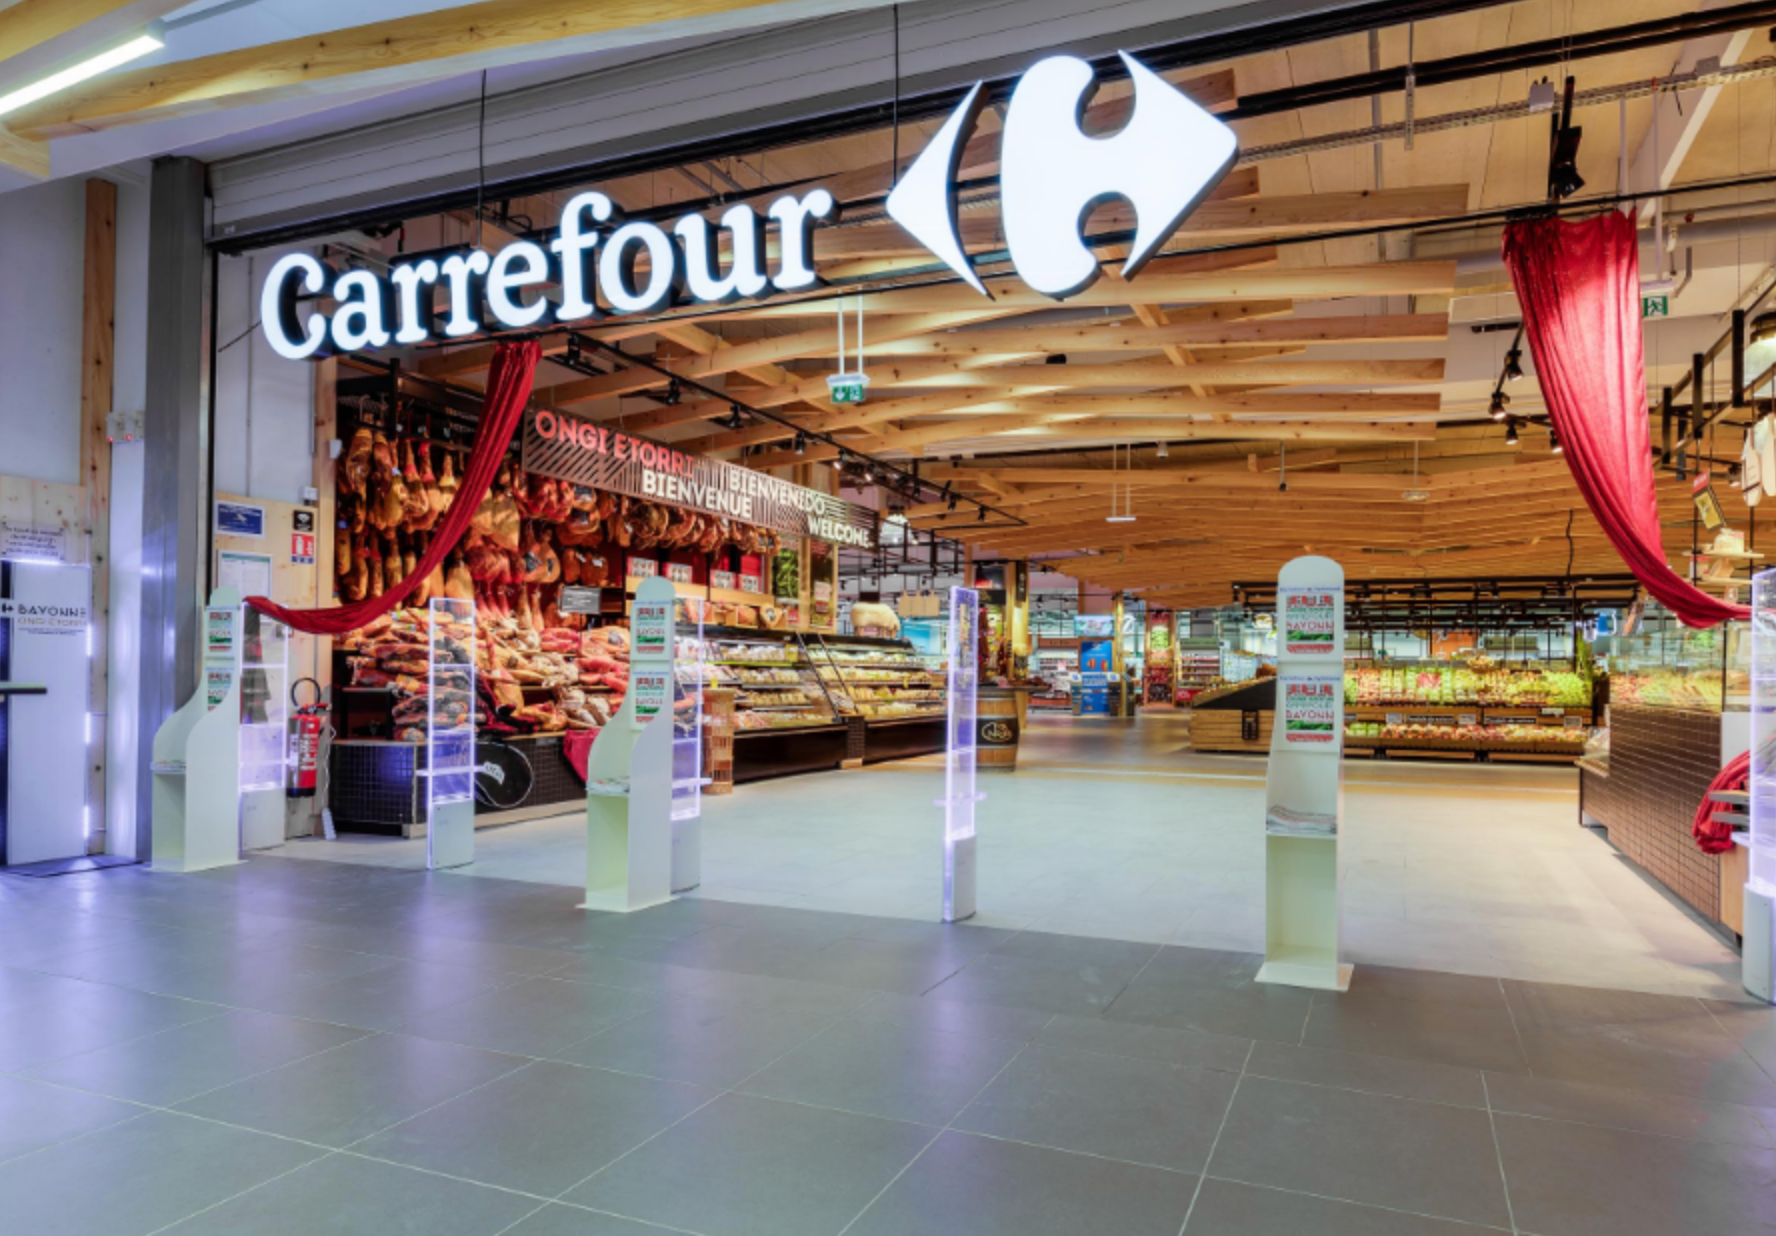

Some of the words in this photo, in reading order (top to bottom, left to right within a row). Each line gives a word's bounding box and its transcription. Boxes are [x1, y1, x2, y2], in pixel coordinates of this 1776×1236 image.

[261, 189, 833, 360] Carrefour
[535, 410, 609, 454] ONGI
[614, 433, 694, 477] ETORRI
[642, 470, 753, 519] BIENVENUE
